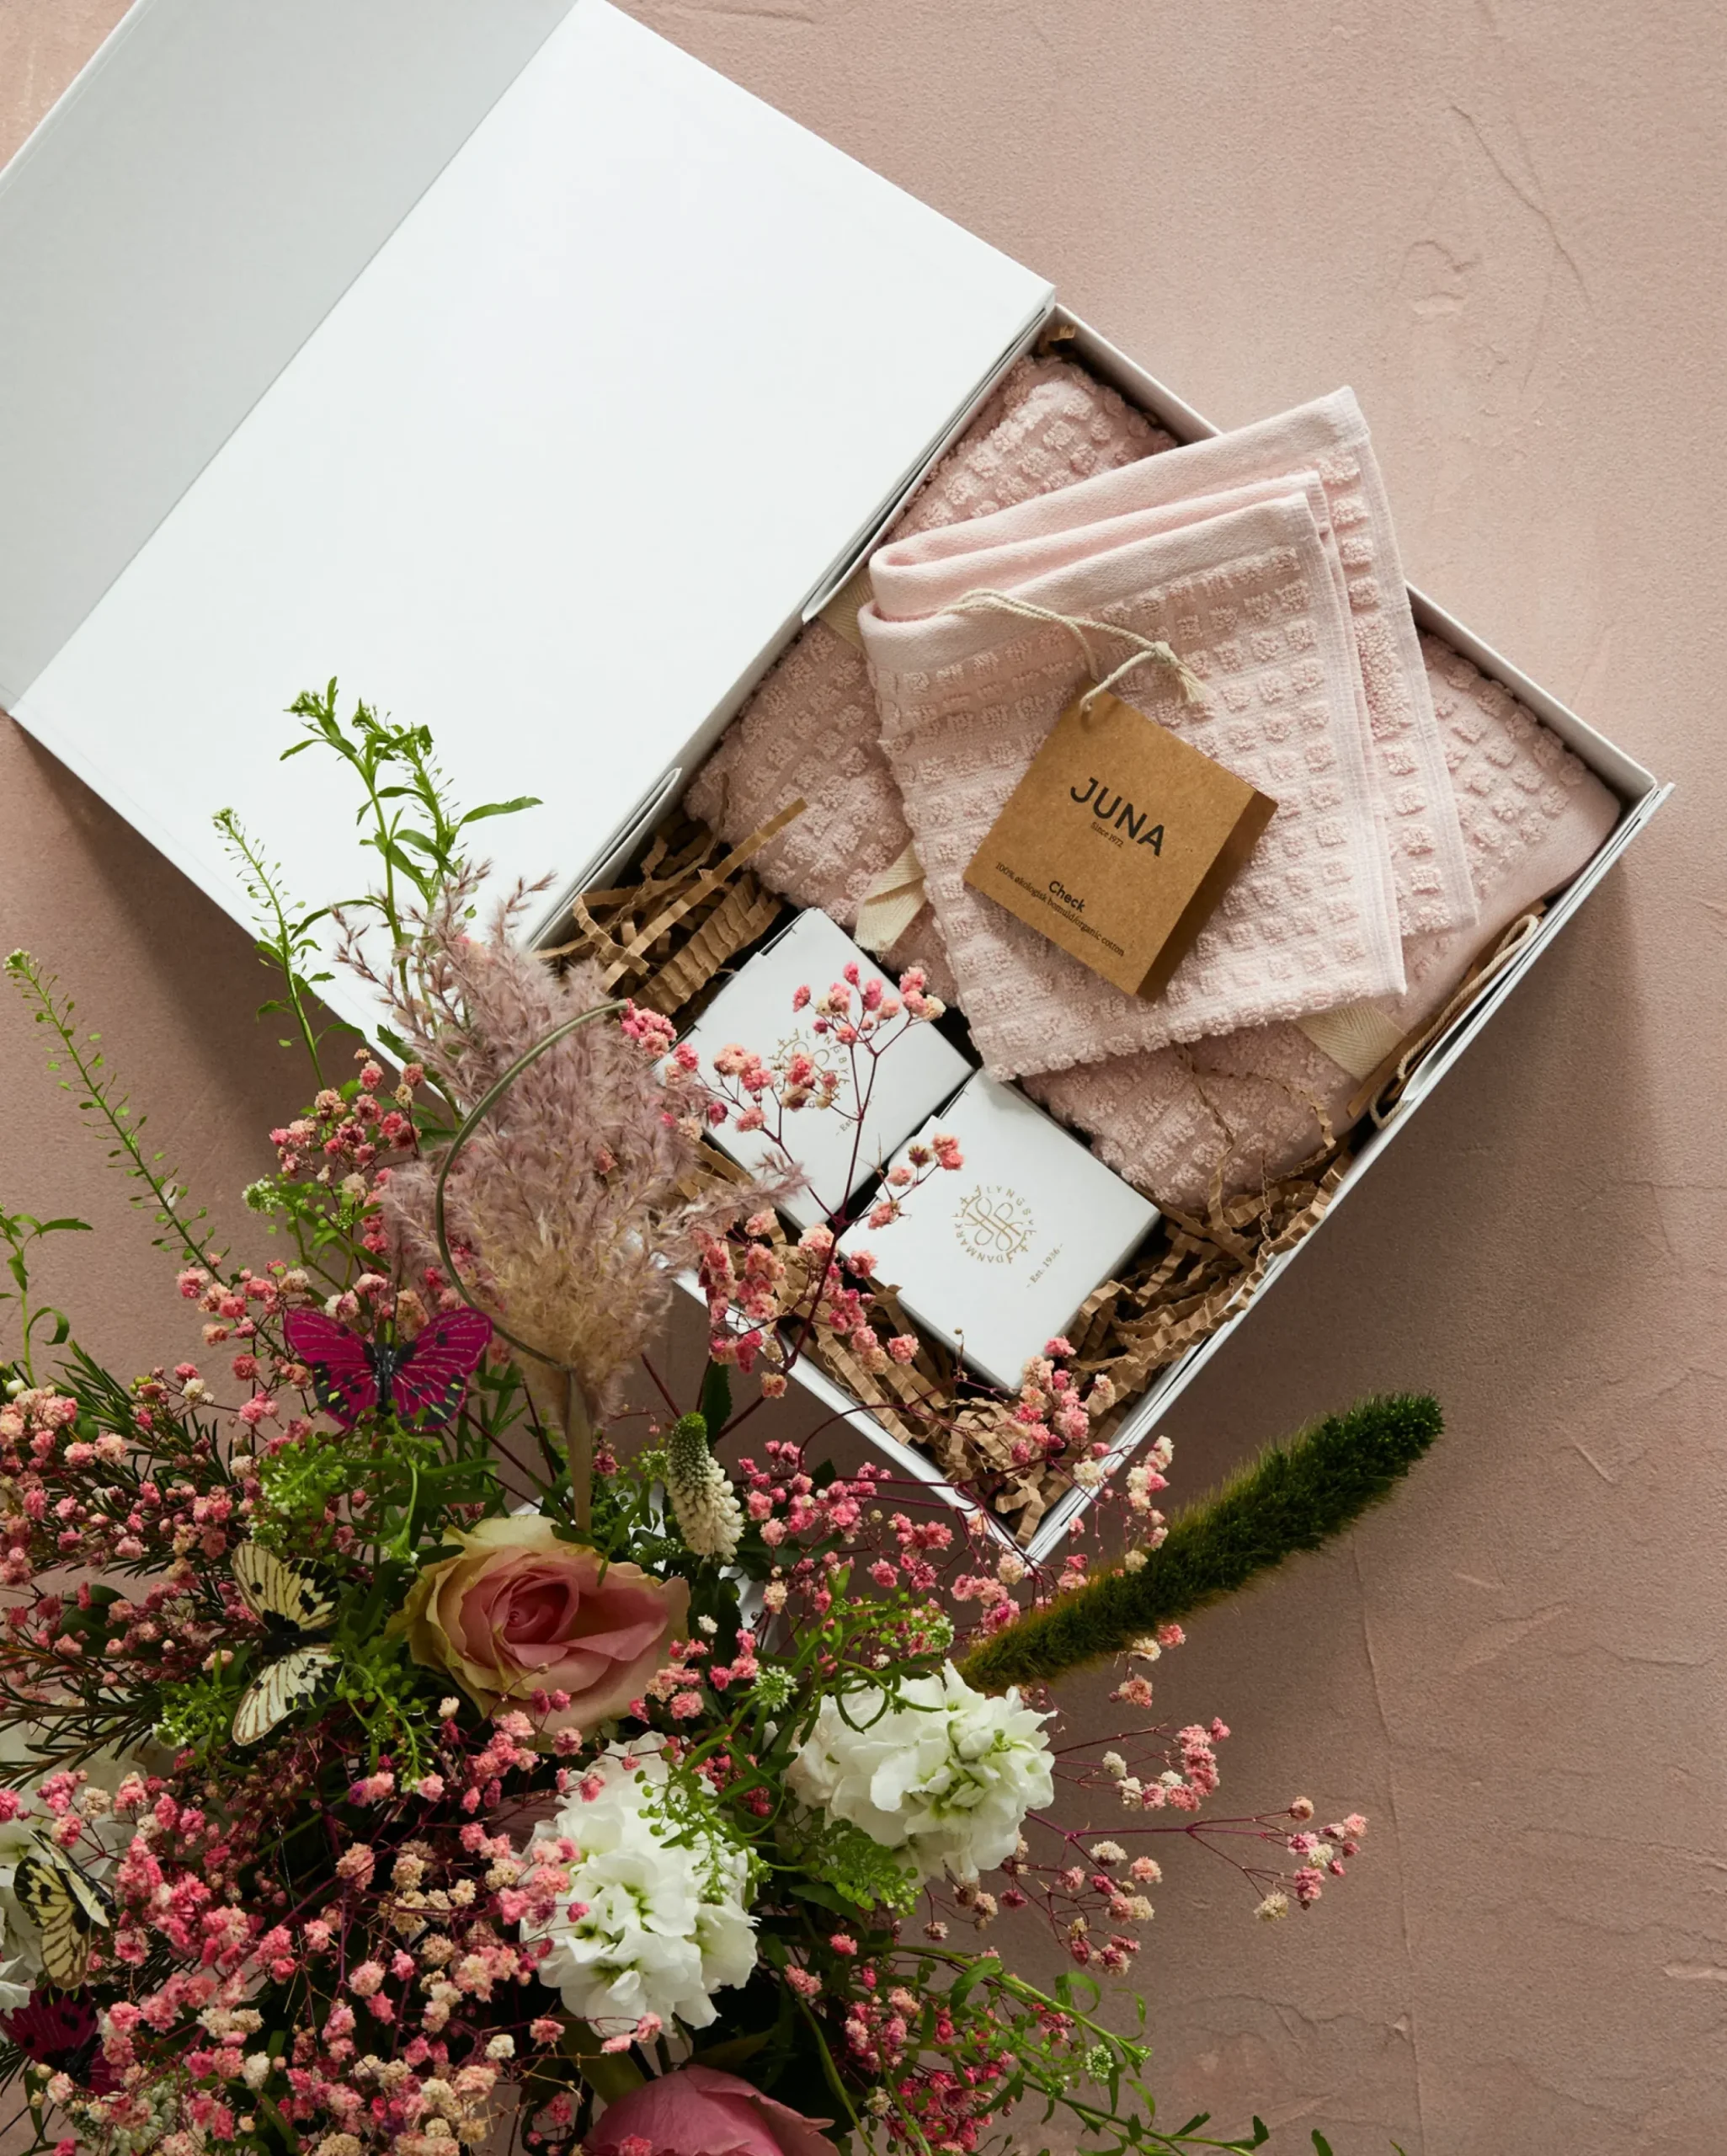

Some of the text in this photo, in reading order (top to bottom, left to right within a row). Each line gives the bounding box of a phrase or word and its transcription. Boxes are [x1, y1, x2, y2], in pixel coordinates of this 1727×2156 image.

[1070, 776, 1165, 857] JUNA
[1090, 822, 1124, 848] Since 1972
[995, 862, 1125, 958] 100% økologisk bomuld/organic cotton
[1048, 880, 1086, 913] Check
[986, 1185, 1034, 1225] LYNGBY
[954, 1223, 1005, 1263] DANMARK
